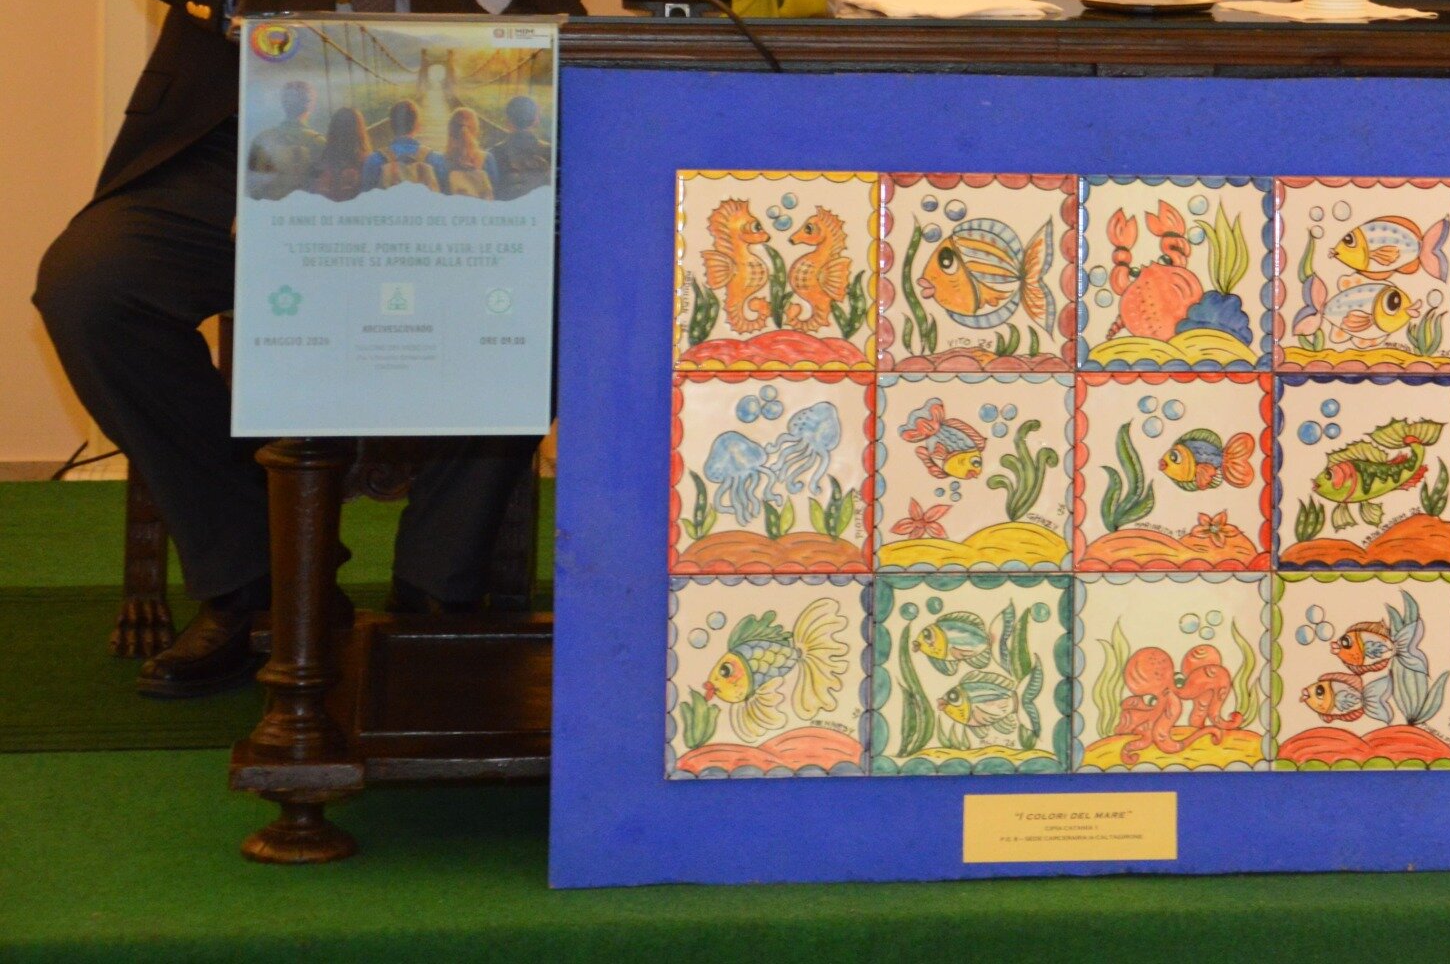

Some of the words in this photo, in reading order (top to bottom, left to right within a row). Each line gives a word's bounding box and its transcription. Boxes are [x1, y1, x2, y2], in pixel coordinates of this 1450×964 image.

[337, 215, 423, 226] ANNIVERSARIO
[375, 242, 410, 254] PONTE
[416, 242, 442, 254] ALLA
[496, 242, 524, 254] CASE
[435, 255, 462, 267] ALLA
[1069, 811, 1091, 820] DEL
